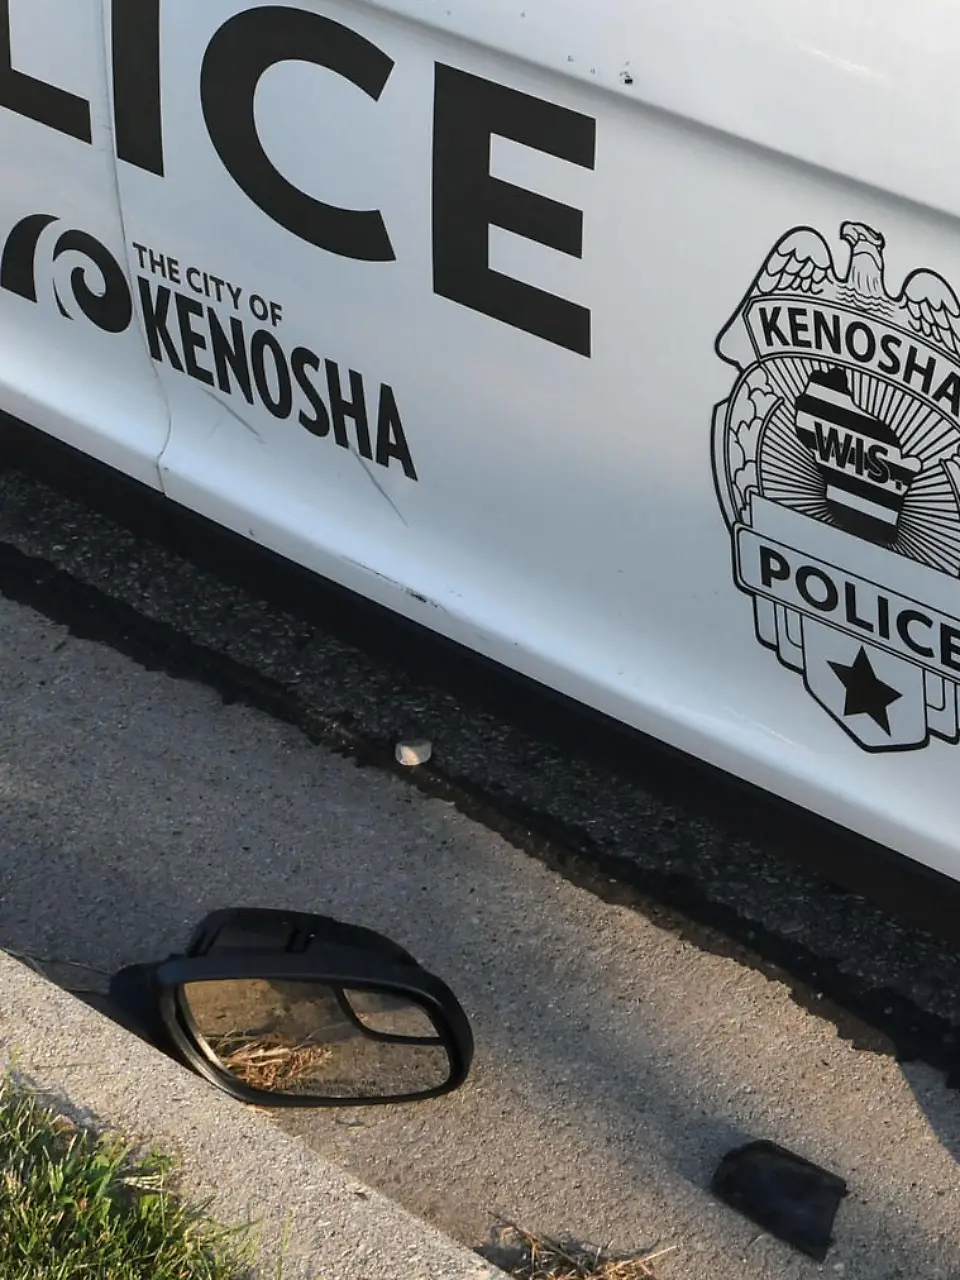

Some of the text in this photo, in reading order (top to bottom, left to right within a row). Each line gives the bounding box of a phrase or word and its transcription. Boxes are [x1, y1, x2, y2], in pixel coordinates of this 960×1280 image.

[133, 242, 283, 327] THE CITY OF
[137, 275, 419, 481] KENOSHA
[758, 306, 960, 417] KENOSHA
